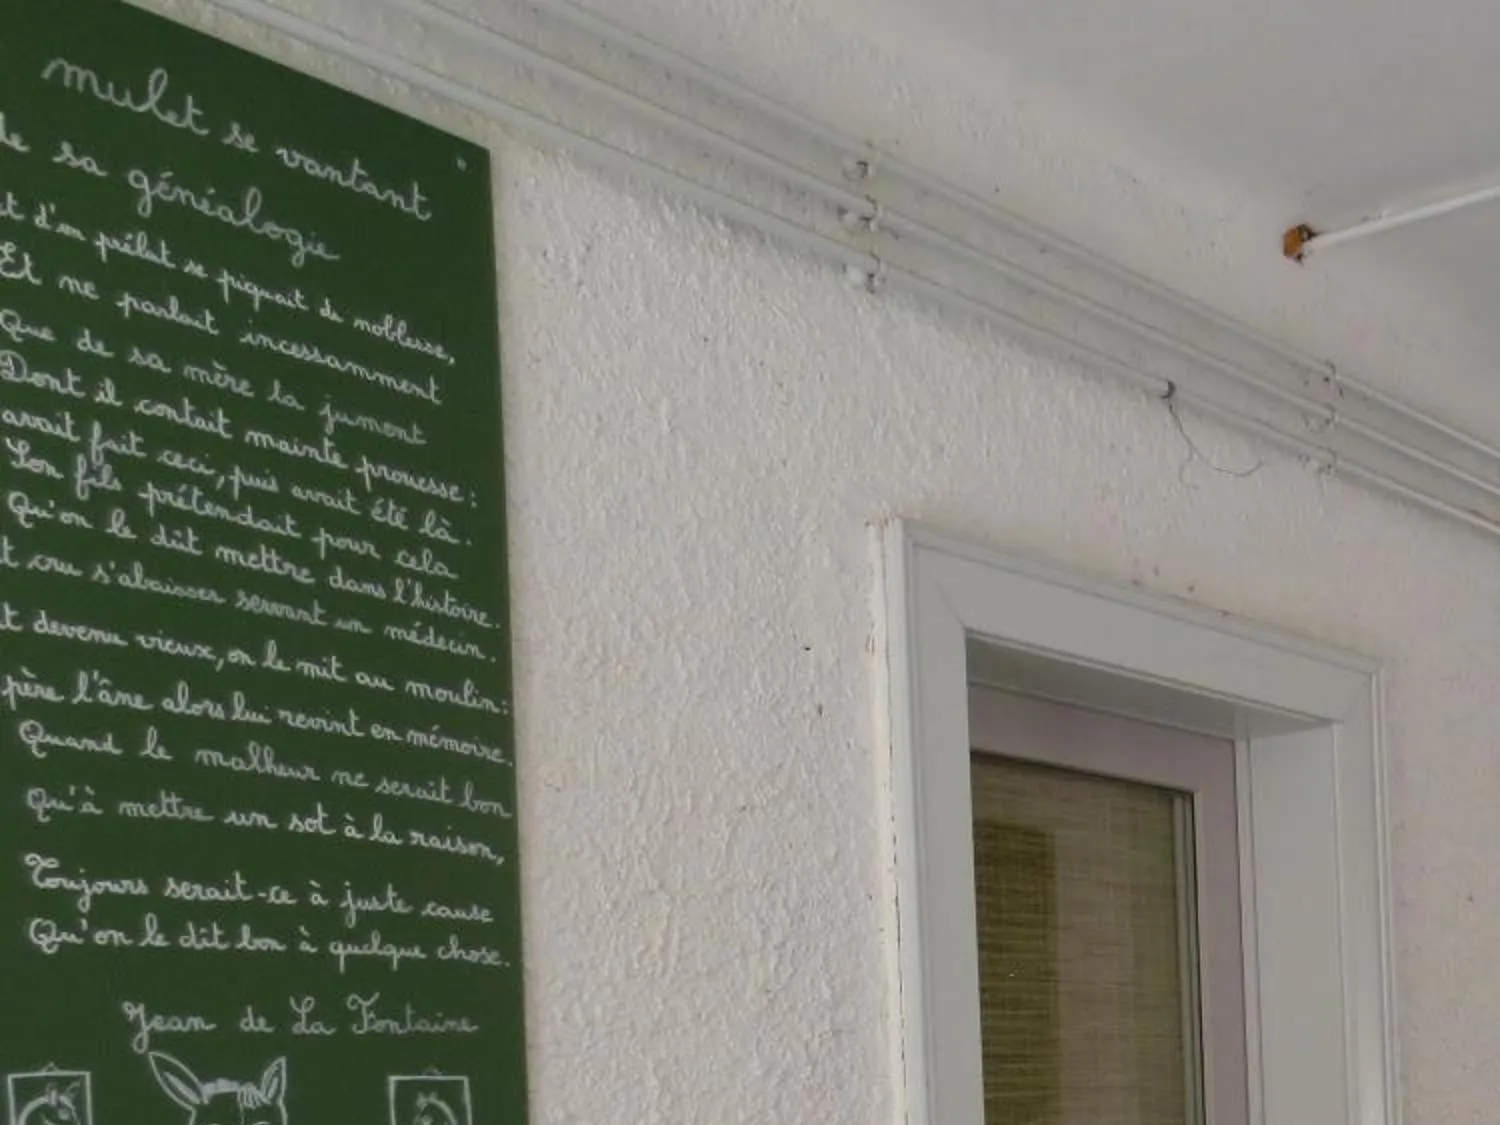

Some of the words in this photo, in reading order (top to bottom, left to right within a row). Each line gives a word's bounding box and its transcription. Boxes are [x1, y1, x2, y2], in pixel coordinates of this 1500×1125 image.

[53, 140, 108, 177] sa
[128, 169, 340, 267] généalogie
[222, 121, 259, 153] se
[276, 146, 432, 221] vantant
[0, 241, 42, 285] Et
[59, 275, 100, 299] ne
[116, 292, 219, 335] parlait
[239, 319, 442, 405] incessamment
[94, 230, 176, 263] prélat
[183, 259, 208, 278] se
[217, 268, 309, 312] piquait
[319, 296, 344, 323] de
[0, 308, 56, 343] Que
[77, 328, 115, 358] de
[128, 346, 171, 373] sa
[183, 358, 254, 397] mère
[267, 378, 305, 411] la
[319, 394, 427, 446] jument
[0, 349, 86, 398] Dont
[94, 377, 122, 406] il
[134, 396, 232, 439] contait
[244, 429, 348, 470] mainte
[2, 410, 80, 443] avait
[91, 419, 146, 468] fait
[228, 465, 279, 501] puis
[291, 487, 361, 516] avait
[75, 453, 122, 501] fils
[137, 481, 301, 538] prétendait
[311, 526, 381, 561] pour
[395, 548, 458, 580] cela
[105, 508, 137, 539] le
[215, 543, 316, 584] mettre
[329, 565, 387, 600] dans
[27, 553, 84, 577] cru
[234, 587, 328, 627] servant
[333, 617, 373, 635] un
[33, 609, 128, 646] devenu
[228, 648, 256, 666] on
[262, 638, 291, 672] le
[296, 655, 348, 683] mit
[355, 671, 395, 692] au
[2, 666, 64, 711] père
[162, 680, 225, 720] alors
[231, 691, 272, 724] lui
[277, 706, 365, 738] revint
[370, 722, 403, 742] en
[19, 719, 123, 759] Quand
[139, 725, 173, 760] le
[195, 740, 320, 782] malheur
[331, 768, 368, 788] ne
[374, 775, 452, 803] serait
[458, 780, 512, 818] bon
[118, 789, 214, 821] mettre
[224, 810, 278, 829] un
[288, 801, 336, 835] sot
[343, 813, 365, 839] à
[369, 812, 404, 845] la
[24, 853, 150, 912] Toujours
[309, 879, 329, 905] à
[340, 880, 414, 929] juste
[421, 900, 494, 923] cause
[29, 916, 133, 954] Qu'on
[139, 912, 171, 947] le
[234, 923, 287, 951] bon
[299, 924, 318, 952] à
[329, 929, 427, 974] quelque
[122, 1000, 217, 1053] Jean
[239, 1003, 274, 1034] de
[289, 994, 337, 1036] La
[345, 990, 479, 1036] Fontaine
